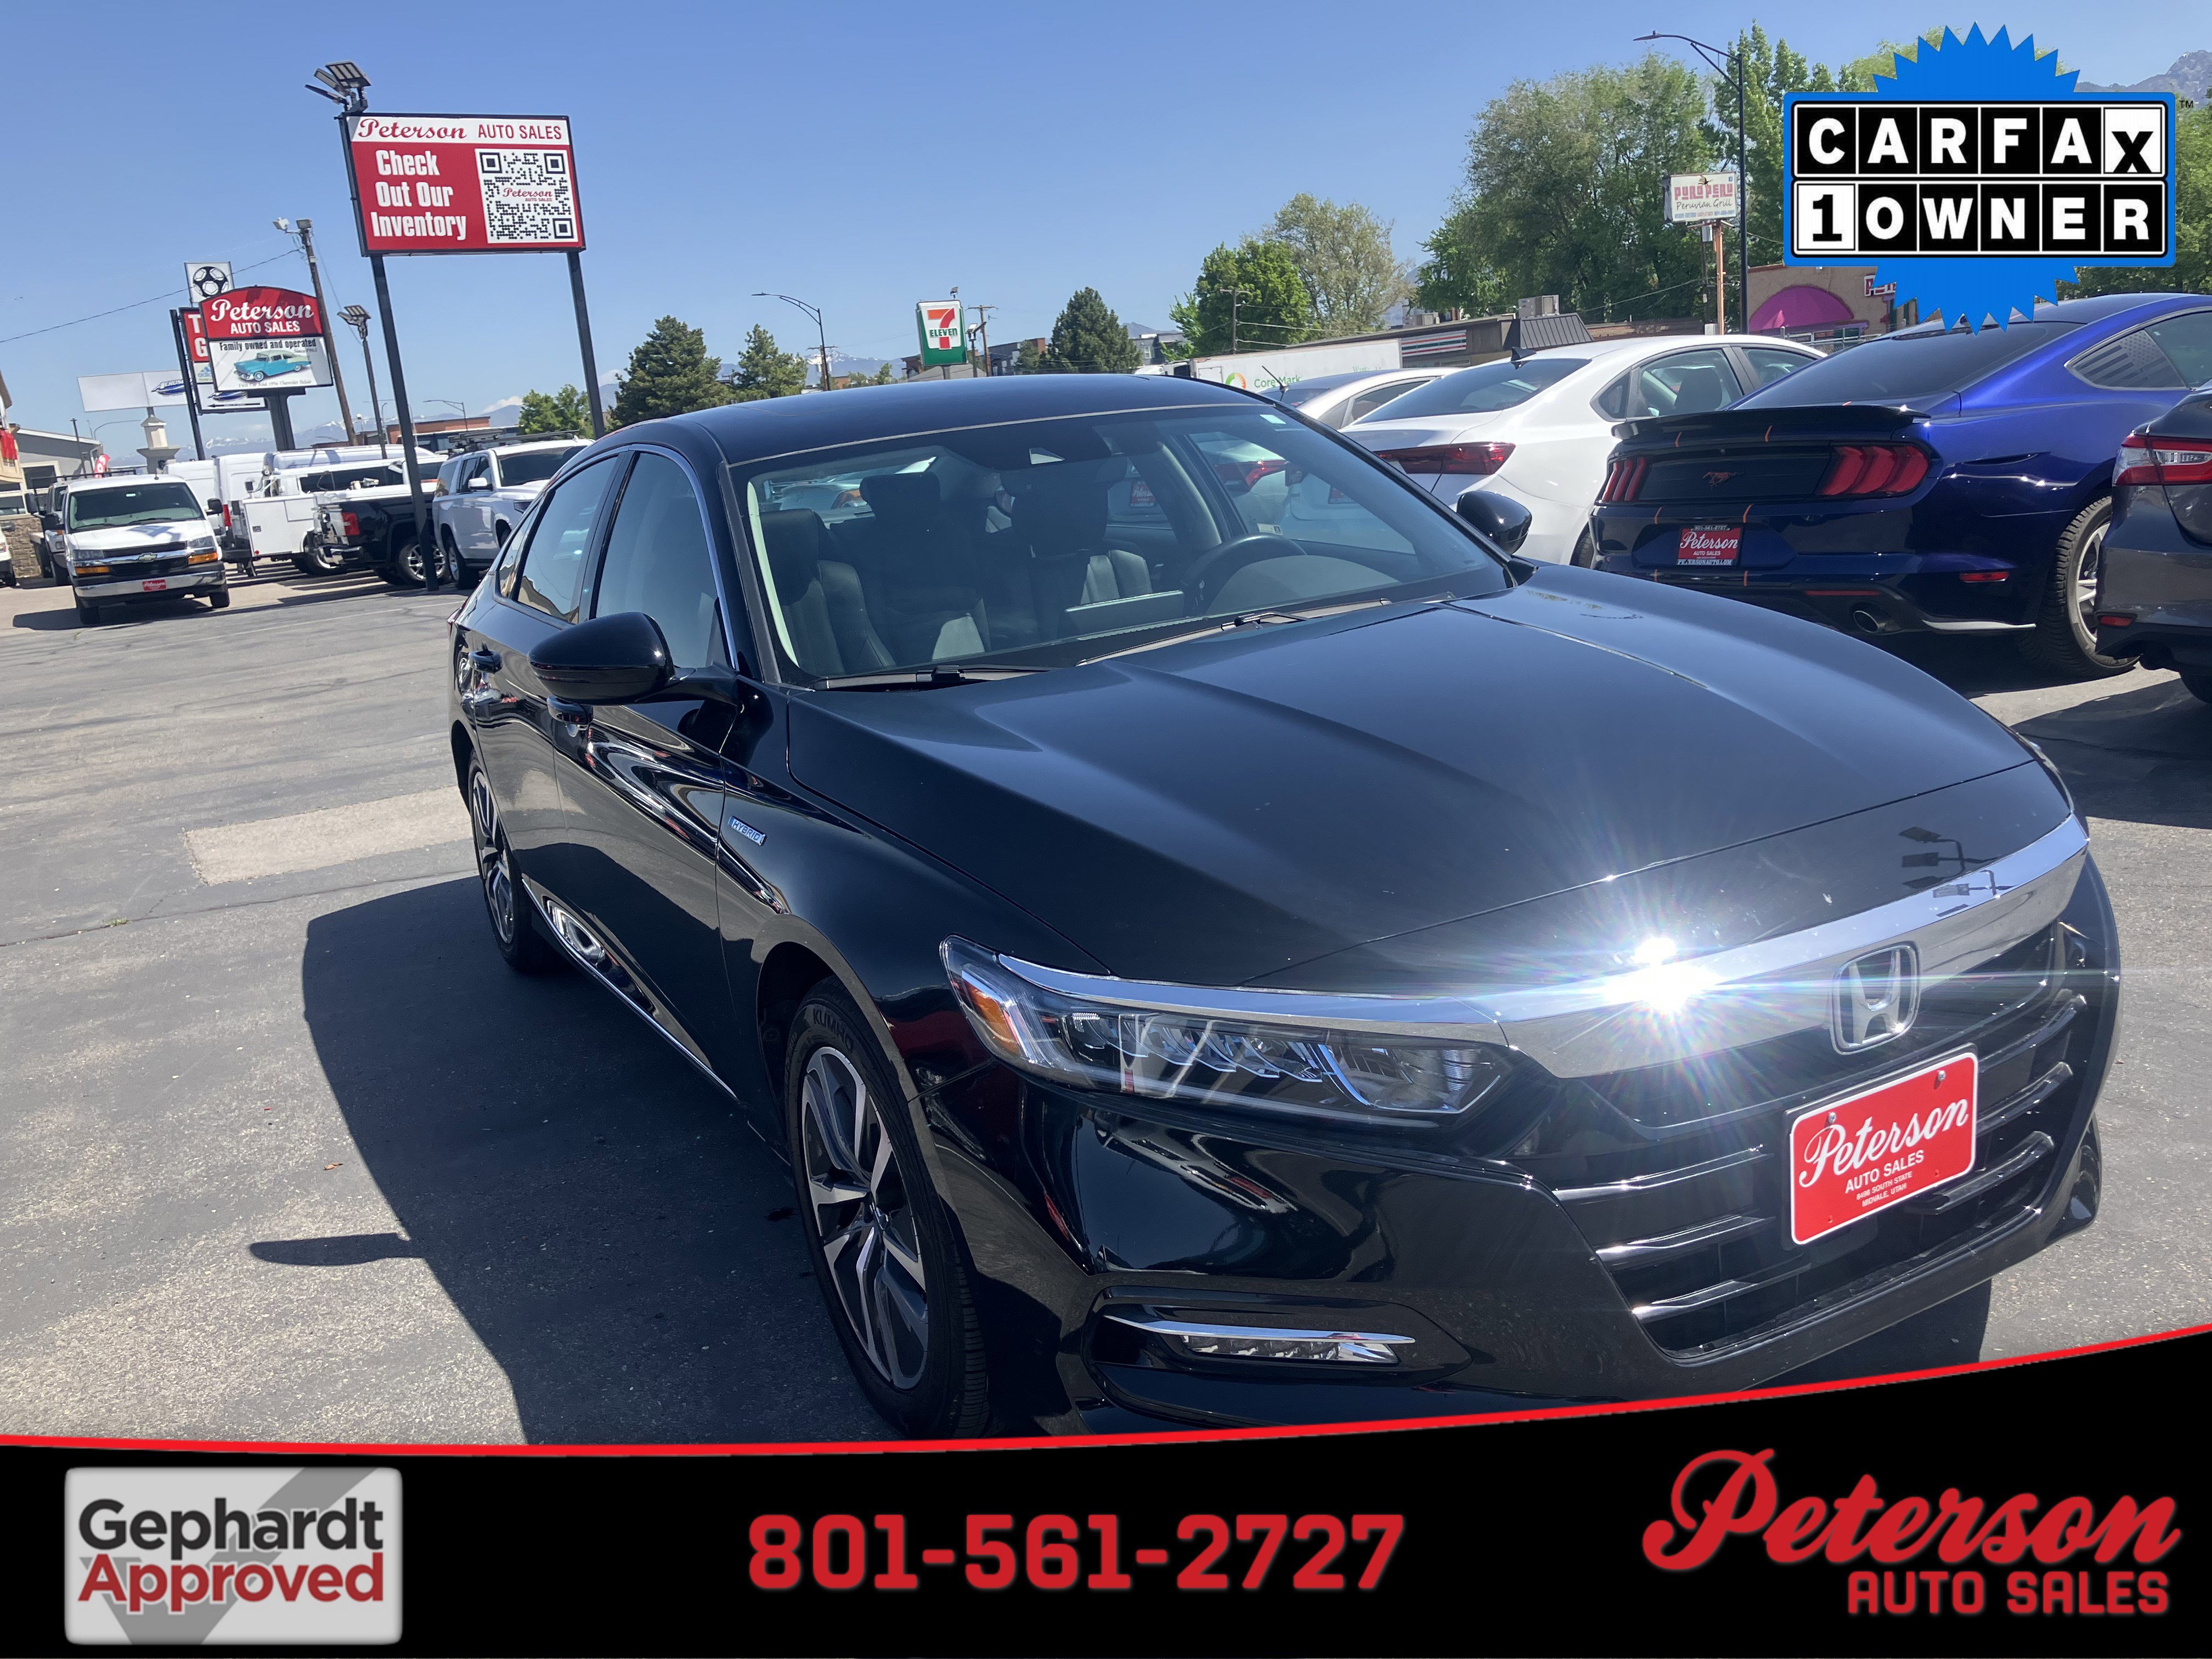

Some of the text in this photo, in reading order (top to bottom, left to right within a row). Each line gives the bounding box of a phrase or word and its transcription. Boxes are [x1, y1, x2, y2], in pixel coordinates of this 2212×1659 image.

[359, 119, 562, 140] Peterson AUTO SALES
[375, 150, 440, 176] Check
[375, 182, 454, 207] Out Our
[503, 188, 552, 197] Peterson
[1677, 198, 1732, 211] Peruvian Grill
[370, 212, 467, 241] Inventory
[210, 299, 314, 321] Peterson
[230, 320, 301, 334] AUTO SALES
[220, 338, 317, 352] Family owned and operated
[1254, 375, 1300, 388] Core Mark
[1680, 531, 1738, 549] Peterson
[732, 821, 760, 840] HYBRID
[1799, 1098, 1969, 1188] Peterson
[1845, 1150, 1924, 1194] AUTO SALES
[1871, 1180, 1893, 1194] SOUTH
[1894, 1171, 1912, 1184] STATE
[1891, 1182, 1908, 1194] UTAH
